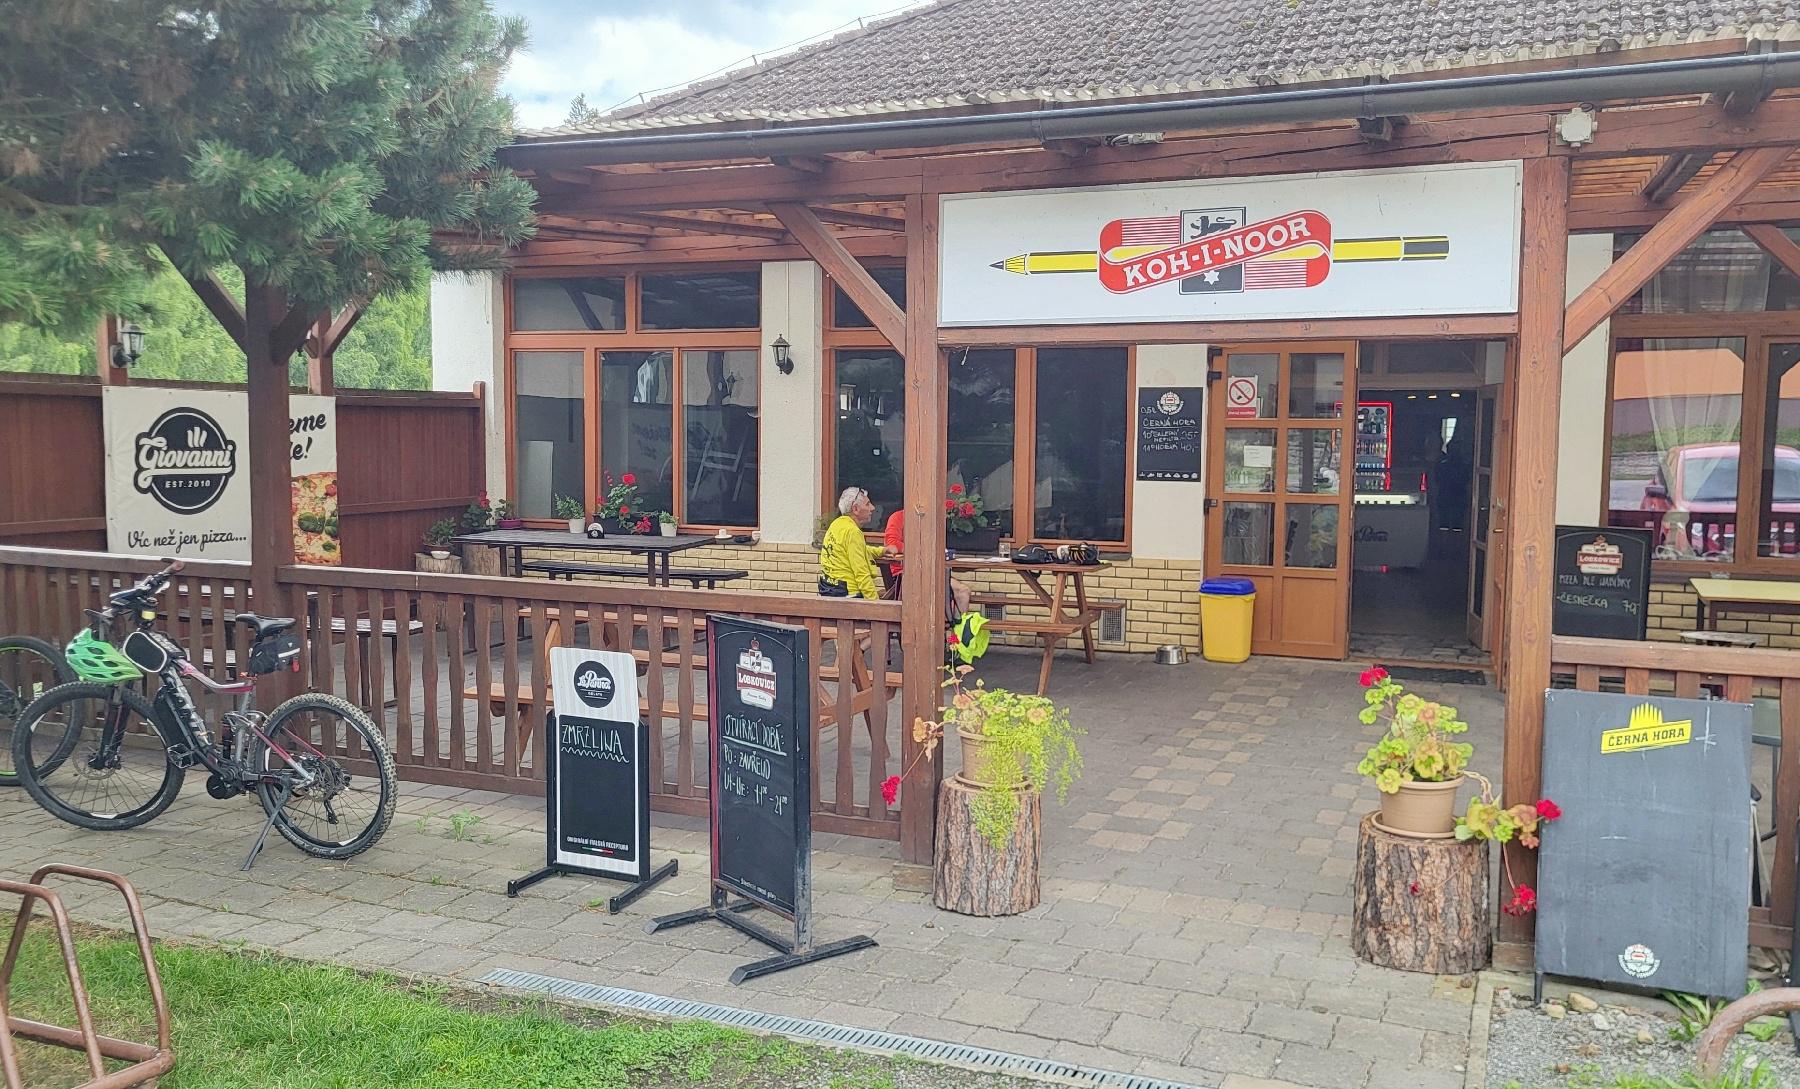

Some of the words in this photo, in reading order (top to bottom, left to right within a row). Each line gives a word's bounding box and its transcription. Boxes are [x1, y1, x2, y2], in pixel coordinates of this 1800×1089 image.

[1123, 217, 1311, 287] KOH-I-NOOR
[138, 437, 233, 489] Giovanni
[128, 530, 151, 548] Víc
[154, 529, 177, 546] než
[176, 531, 199, 554] jen
[1559, 574, 1579, 585] PIZZA
[738, 673, 775, 691] LOBKOWICZ
[561, 725, 624, 756] ZMRZLINA
[1652, 727, 1685, 741] HORA
